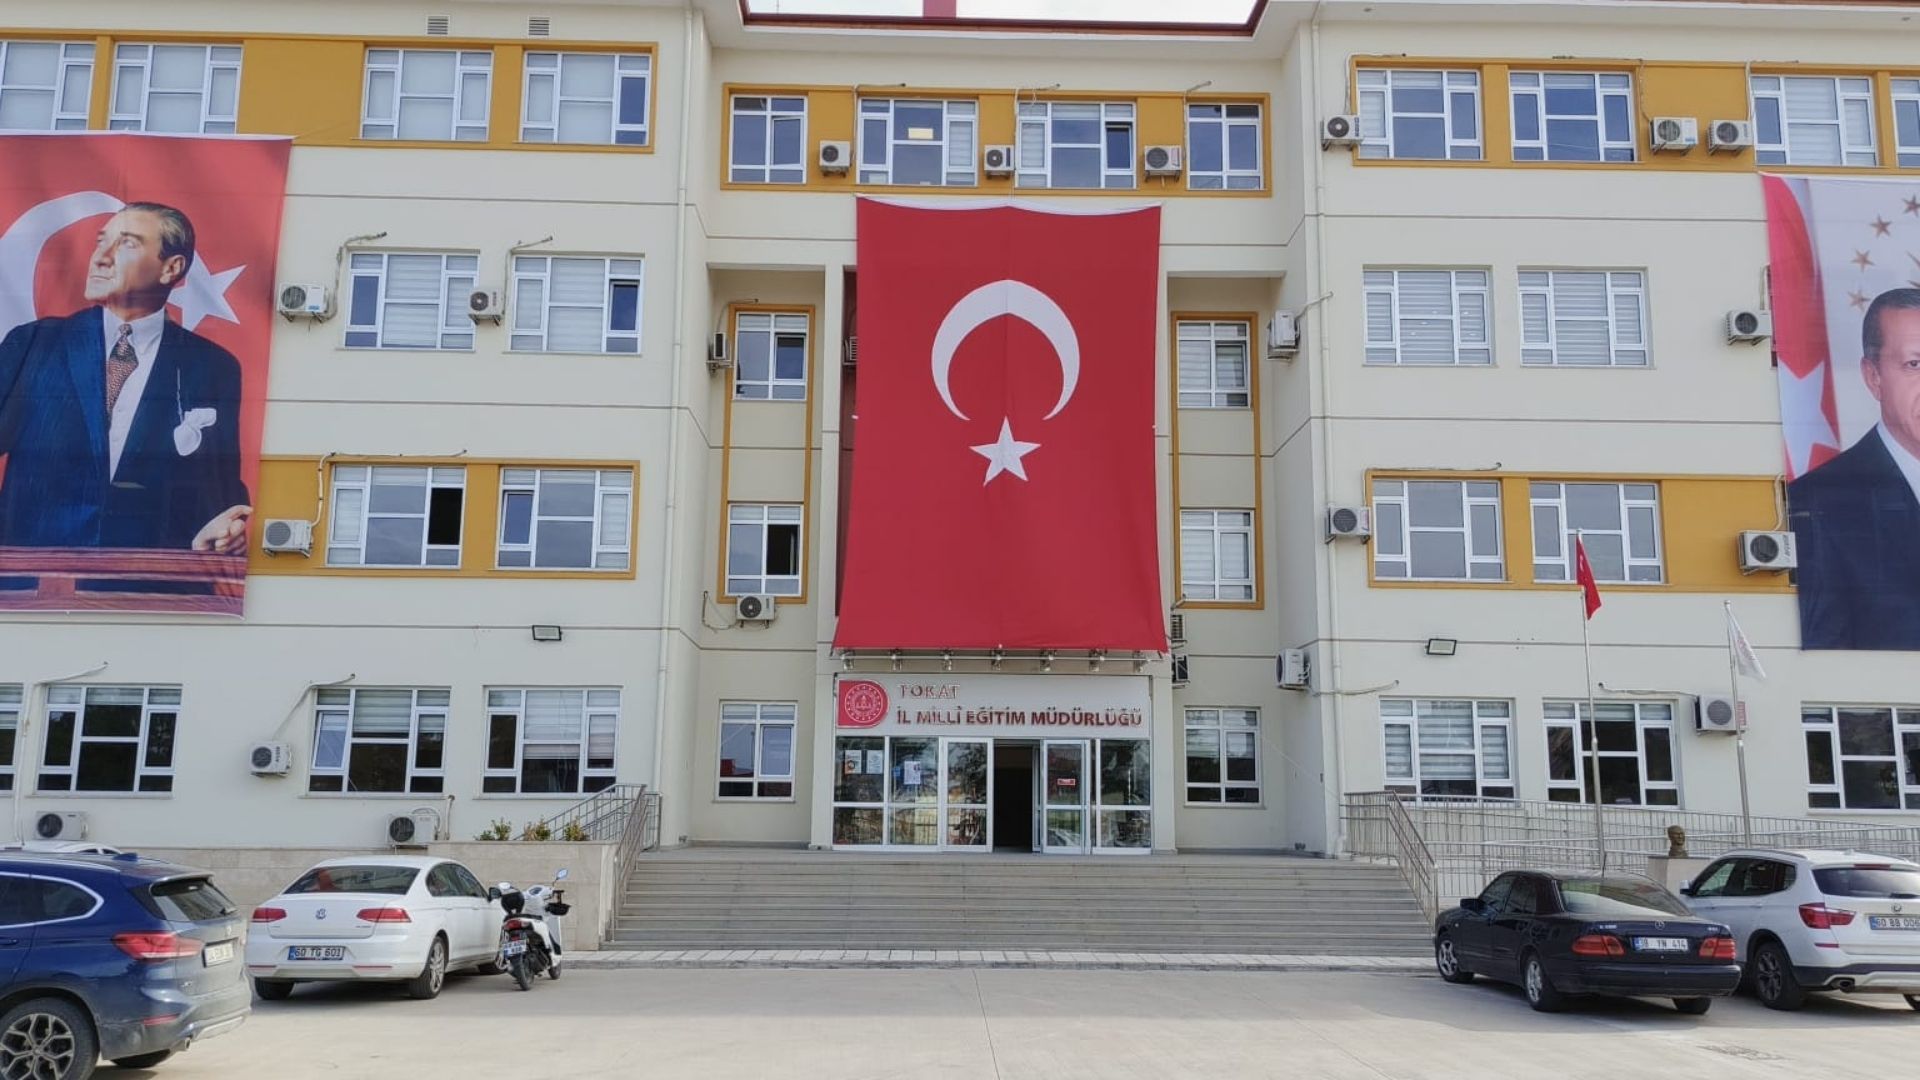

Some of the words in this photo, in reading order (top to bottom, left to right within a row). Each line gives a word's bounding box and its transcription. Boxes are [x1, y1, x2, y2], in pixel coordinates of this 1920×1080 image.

[898, 684, 960, 700] TOKAT
[897, 705, 911, 724] İL
[916, 705, 962, 725] MİLLİ
[966, 706, 1025, 725] EĞİTİM
[1031, 706, 1142, 726] MÜDÜRLÜĞÜ
